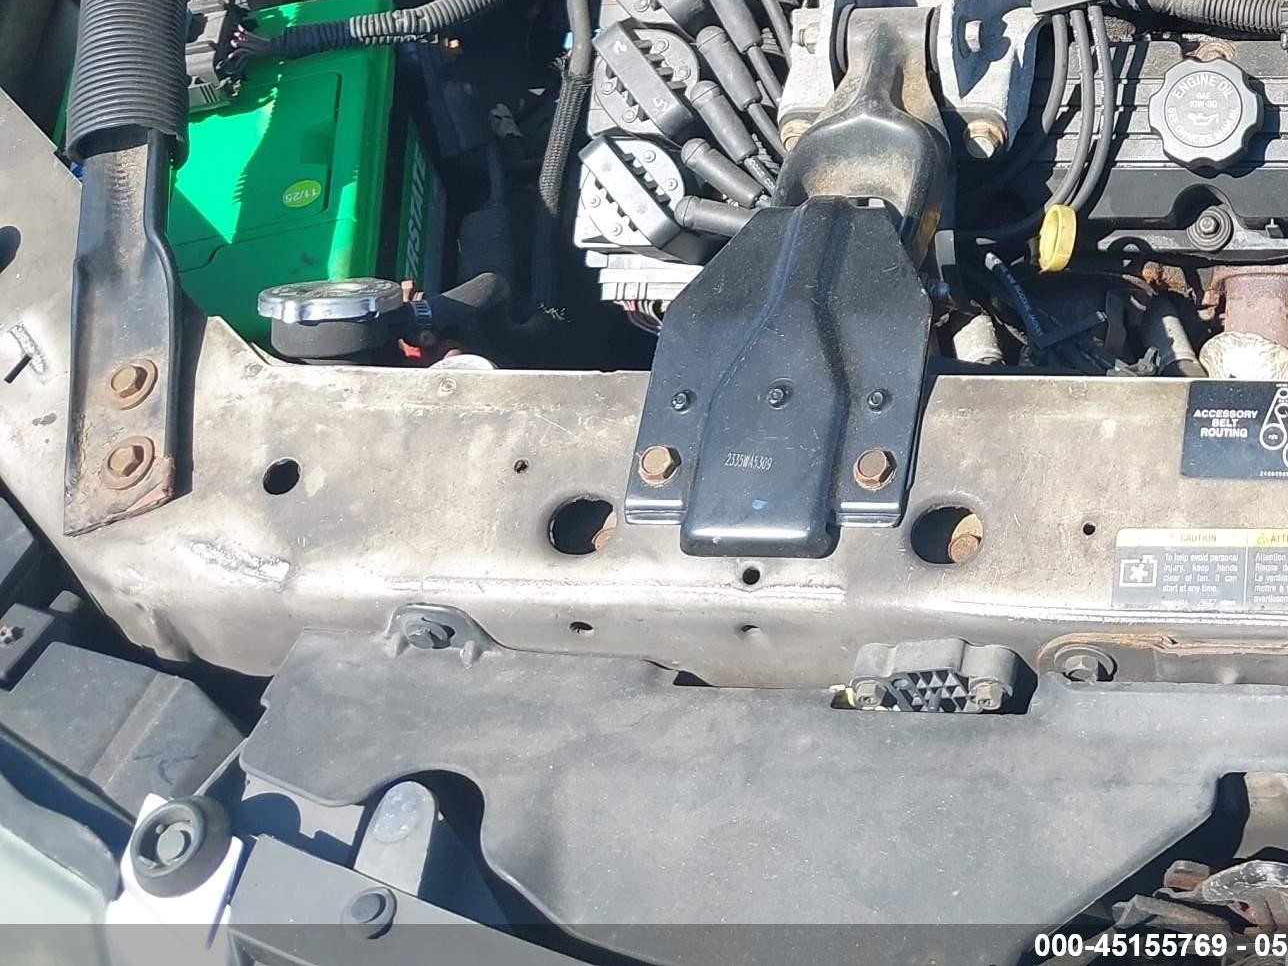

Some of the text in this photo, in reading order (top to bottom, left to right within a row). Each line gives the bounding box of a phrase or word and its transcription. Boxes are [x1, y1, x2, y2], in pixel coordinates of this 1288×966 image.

[1172, 74, 1234, 100] ENGINE OIL
[1189, 100, 1218, 108] 10W-30
[284, 185, 318, 202] 11/25
[1193, 410, 1258, 419] ACCESSORY
[1211, 419, 1239, 428] BELT
[1200, 428, 1249, 438] ROUTING
[1180, 534, 1216, 542] CAUTION
[1166, 553, 1172, 561] To
[1174, 554, 1189, 562] help
[1210, 554, 1238, 562] personal
[1192, 564, 1210, 572] keep
[1217, 563, 1238, 572] hands
[1163, 574, 1180, 582] clear
[1185, 574, 1192, 582] of
[1186, 585, 1200, 594] any
